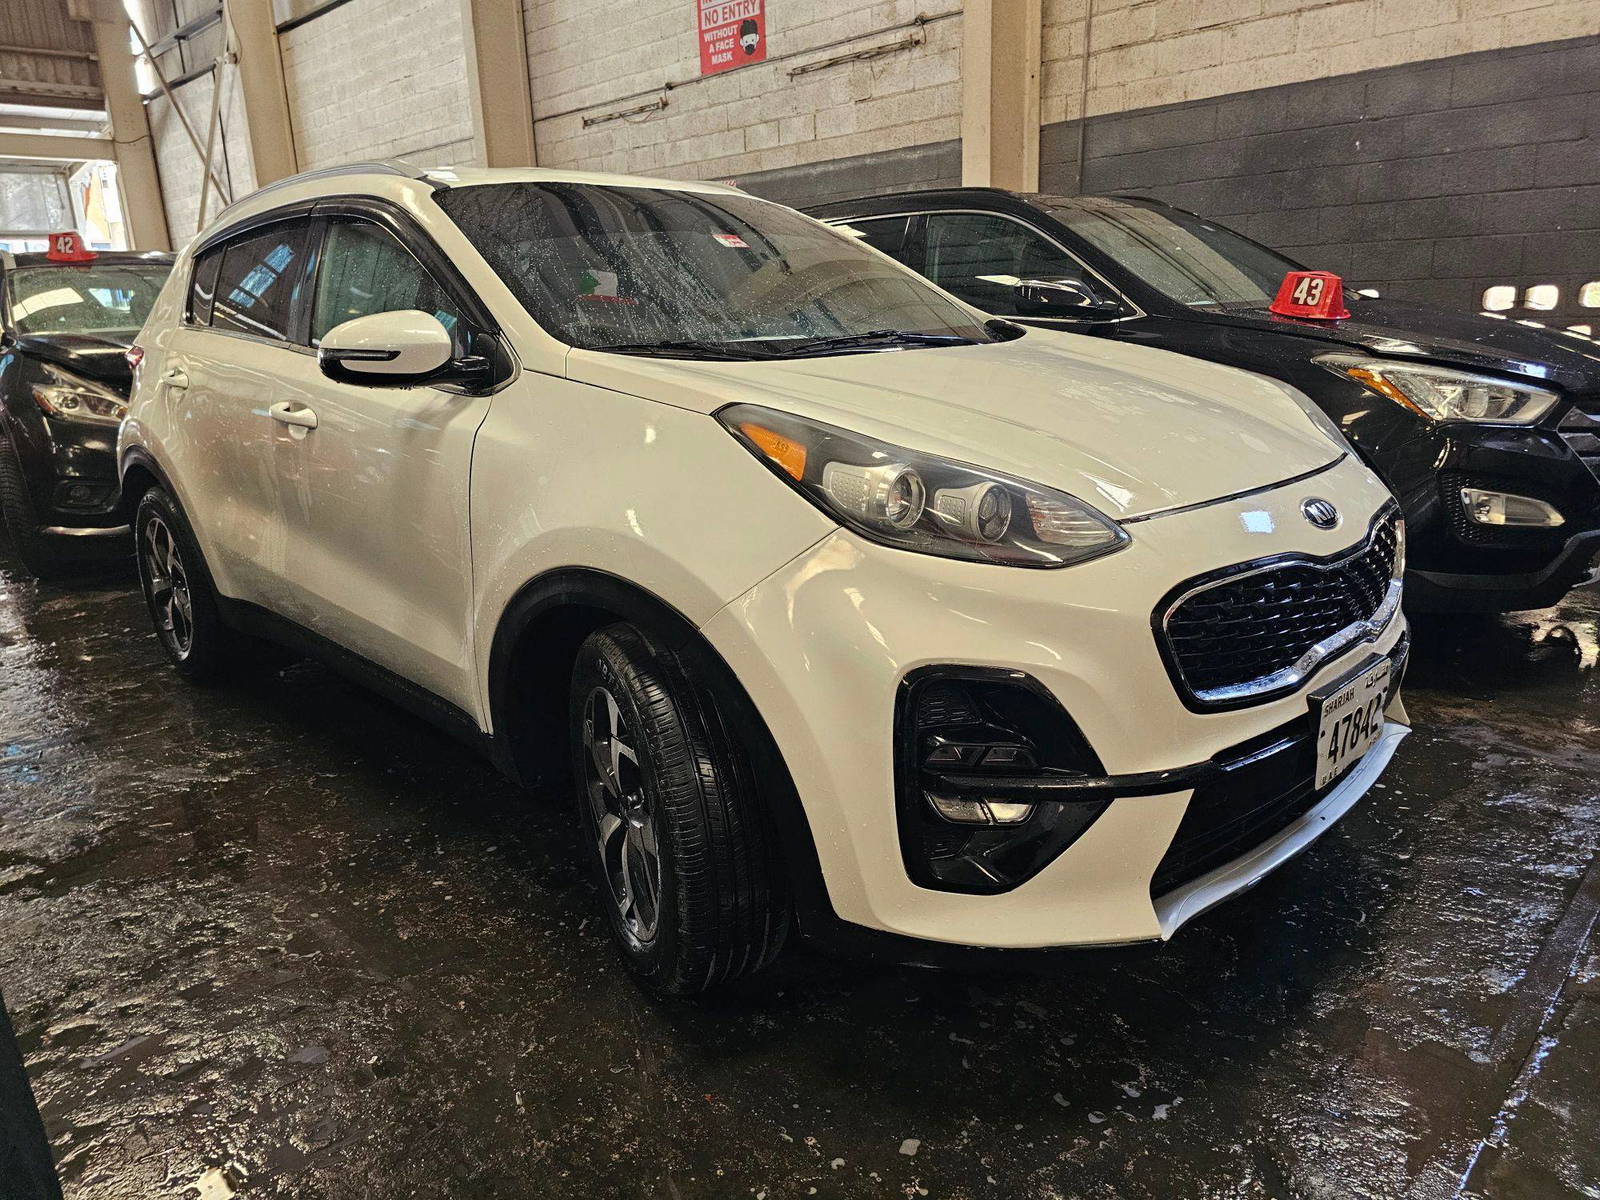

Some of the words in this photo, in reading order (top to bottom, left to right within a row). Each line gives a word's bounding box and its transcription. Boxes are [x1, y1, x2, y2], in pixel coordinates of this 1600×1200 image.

[704, 9, 718, 27] NO
[722, 0, 757, 21] ENTRY
[704, 25, 738, 42] WITHOUT
[709, 43, 715, 53] A
[715, 39, 735, 52] FACE
[711, 51, 733, 64] MASK
[57, 237, 73, 254] 42
[1293, 277, 1324, 306] 43
[1324, 686, 1355, 718] SHARJAH
[1328, 692, 1382, 763] 47842
